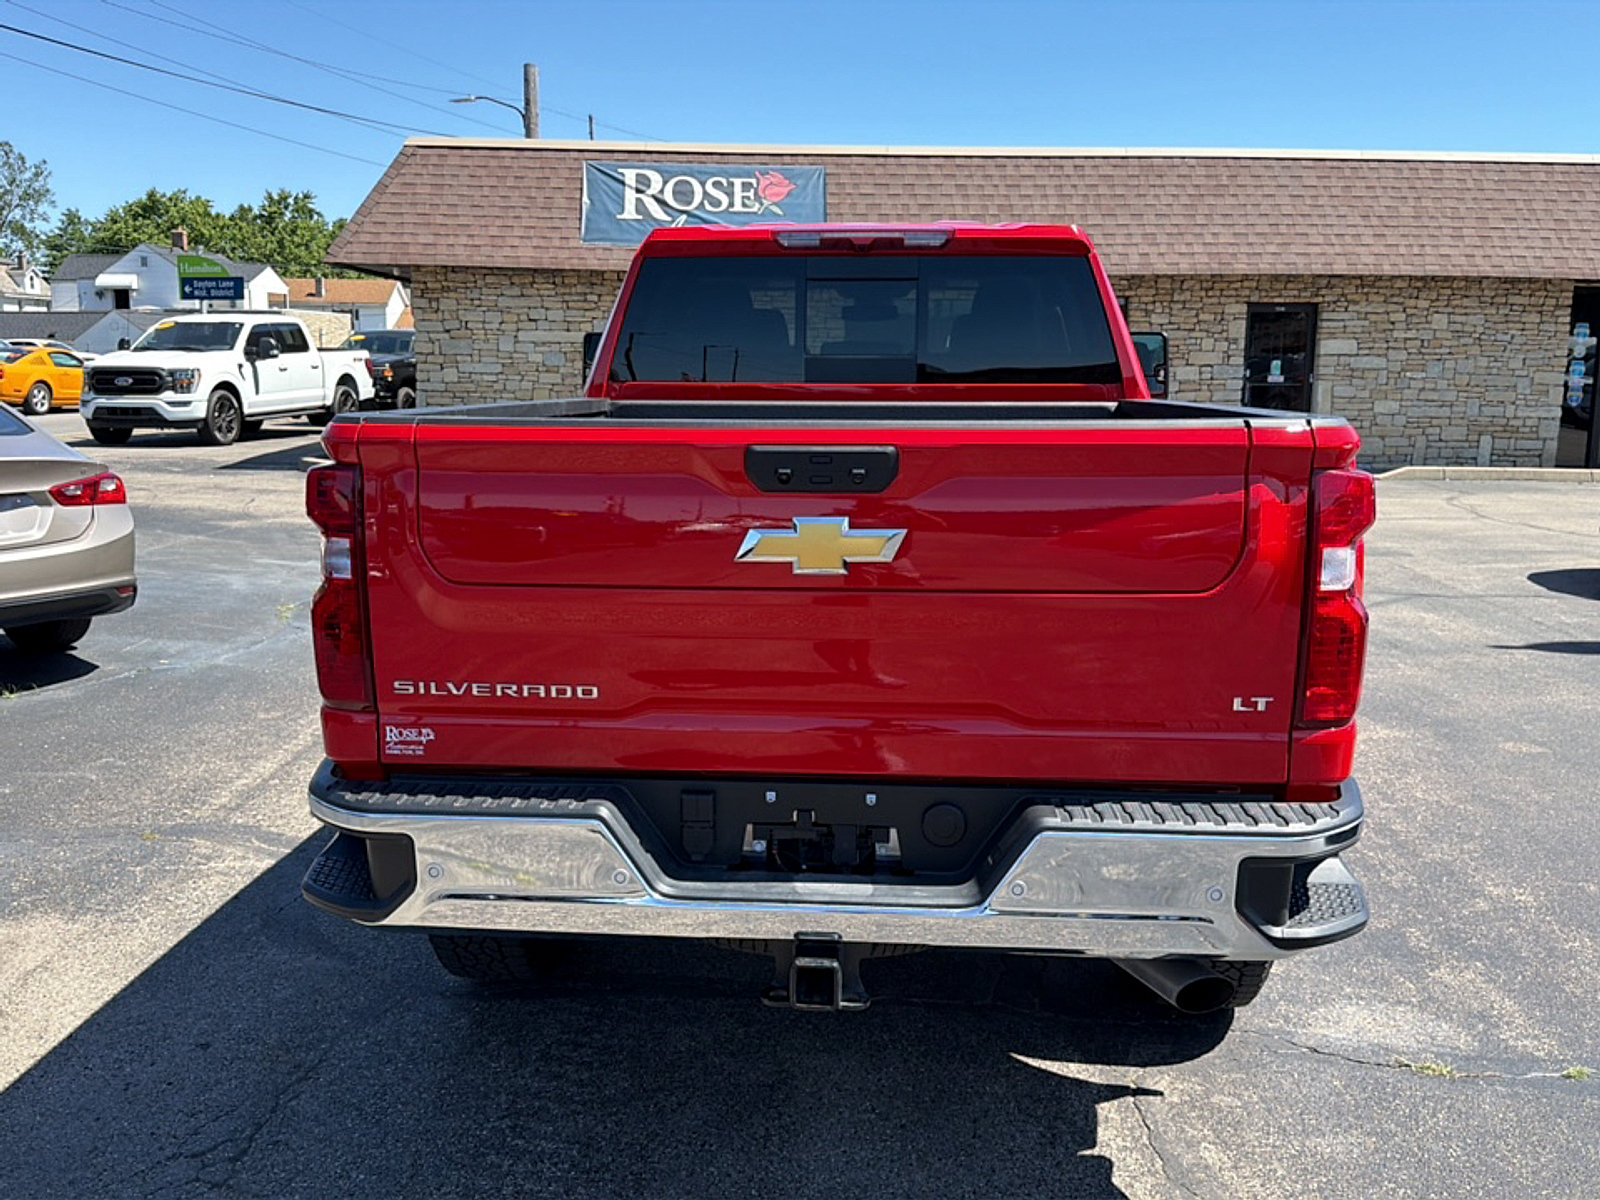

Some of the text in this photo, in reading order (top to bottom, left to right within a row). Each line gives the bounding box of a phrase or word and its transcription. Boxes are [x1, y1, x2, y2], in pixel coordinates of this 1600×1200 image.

[616, 168, 760, 222] ROSE
[393, 680, 599, 699] SILVERADO
[1233, 696, 1274, 712] LT
